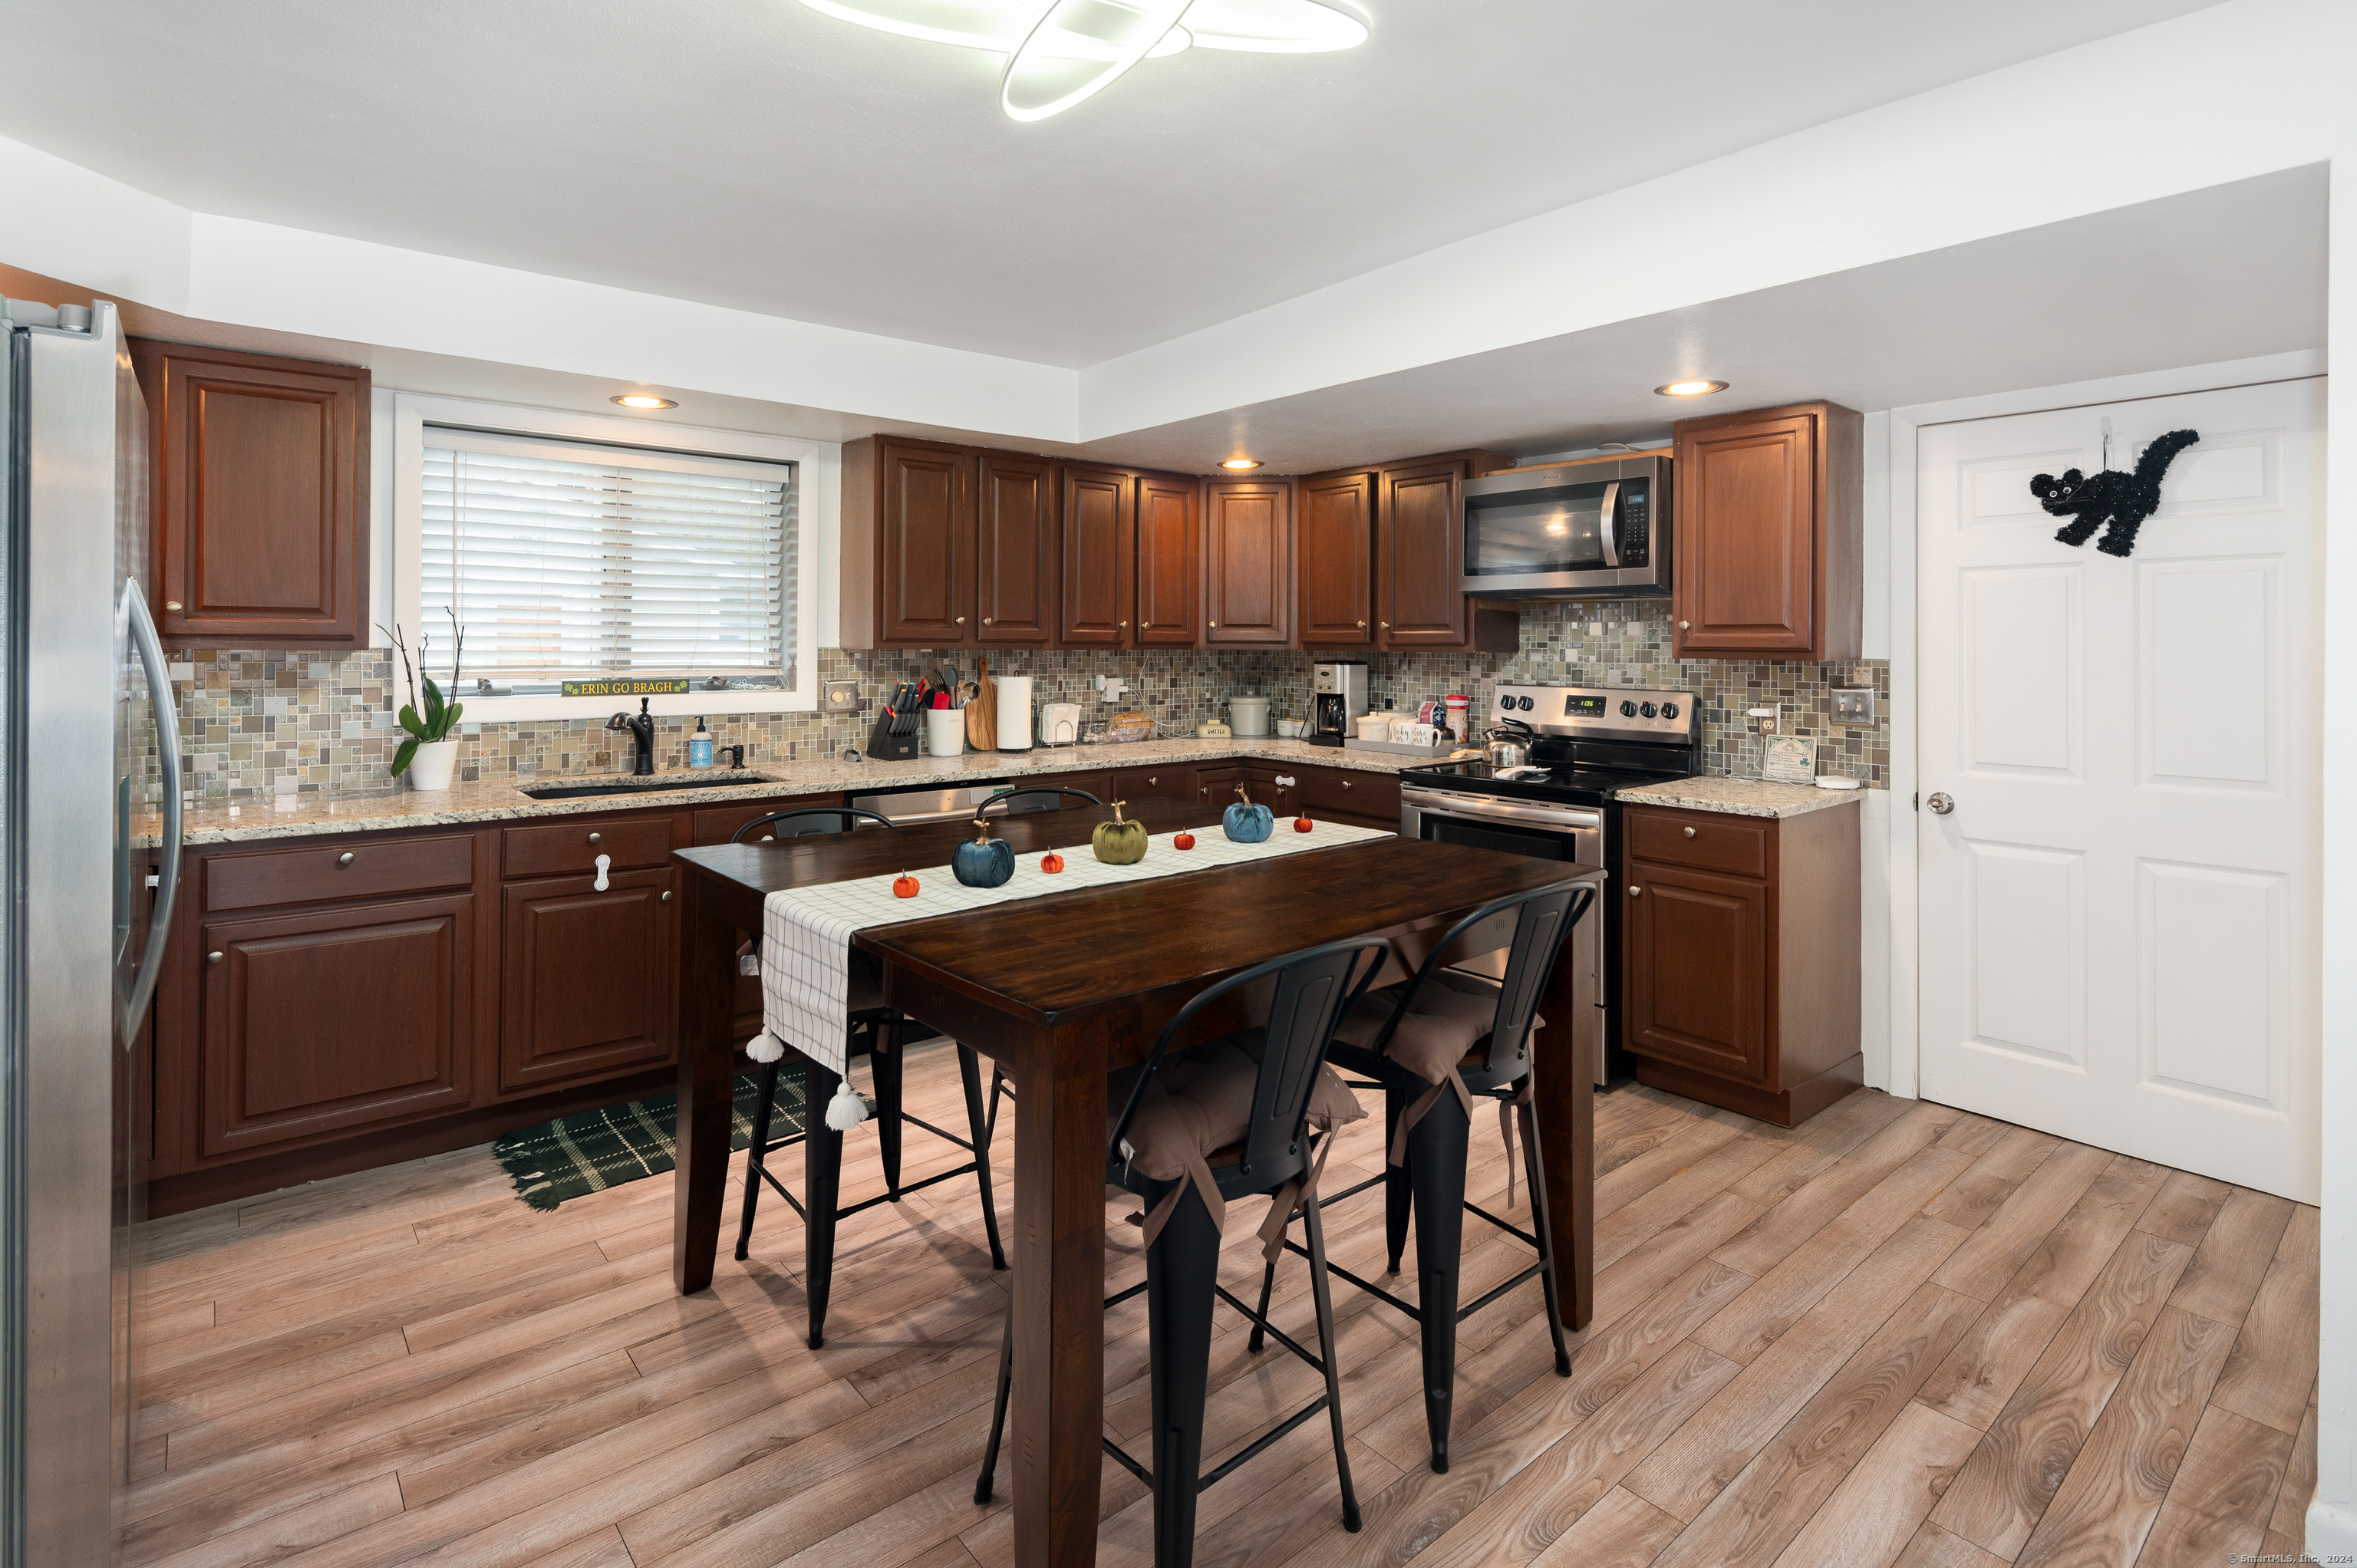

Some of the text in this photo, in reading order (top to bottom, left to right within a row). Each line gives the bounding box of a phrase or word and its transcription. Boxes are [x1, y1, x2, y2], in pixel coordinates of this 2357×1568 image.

[581, 682, 672, 694] ERIN GO BRAGH
